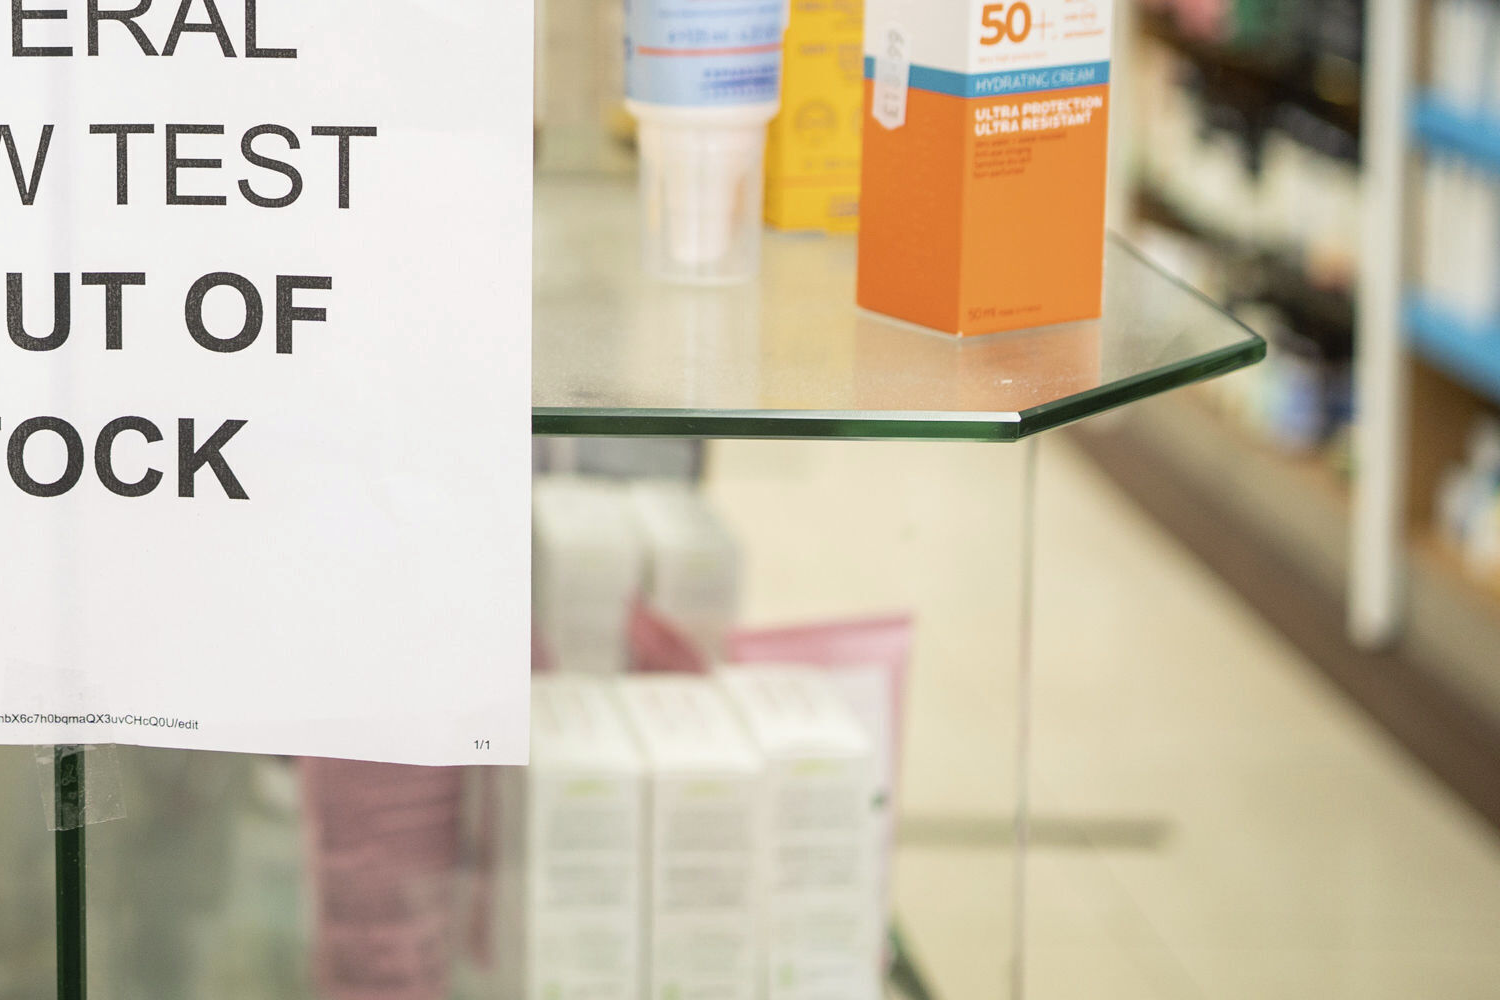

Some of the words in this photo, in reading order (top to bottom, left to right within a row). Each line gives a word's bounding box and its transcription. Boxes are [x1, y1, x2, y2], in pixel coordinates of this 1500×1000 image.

[976, 72, 1049, 92] HYDRATING
[1051, 67, 1095, 85] CREAM
[974, 105, 1019, 122] ULTRA
[1022, 96, 1102, 116] PROTECTION
[974, 119, 1019, 136] ULTRA
[1021, 111, 1092, 132] RESISTANT
[89, 123, 378, 209] TEST
[184, 271, 333, 354] OF
[473, 739, 490, 750] 1/1
